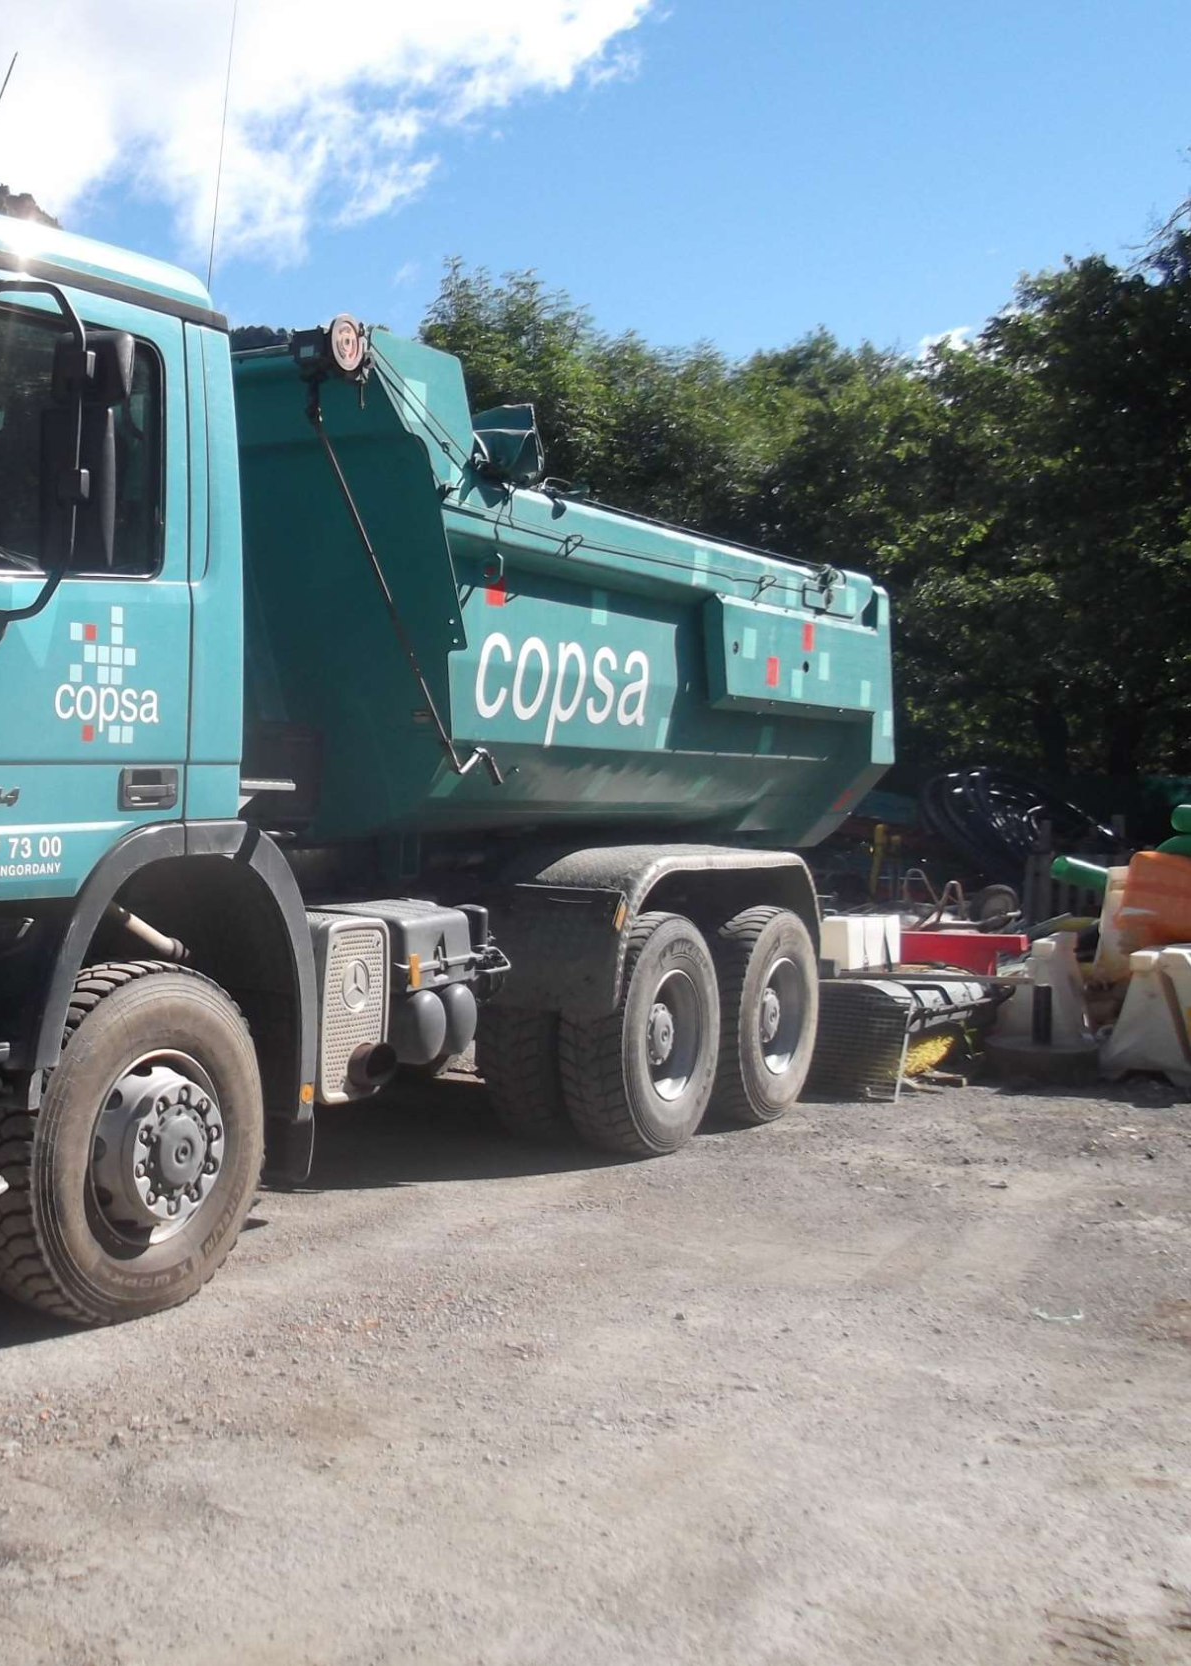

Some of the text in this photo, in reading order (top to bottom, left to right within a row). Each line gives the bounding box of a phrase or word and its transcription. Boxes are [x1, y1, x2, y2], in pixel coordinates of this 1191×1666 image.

[55, 684, 159, 733] copsa
[475, 632, 649, 748] copsa
[8, 837, 32, 859] 73
[39, 835, 62, 857] 00
